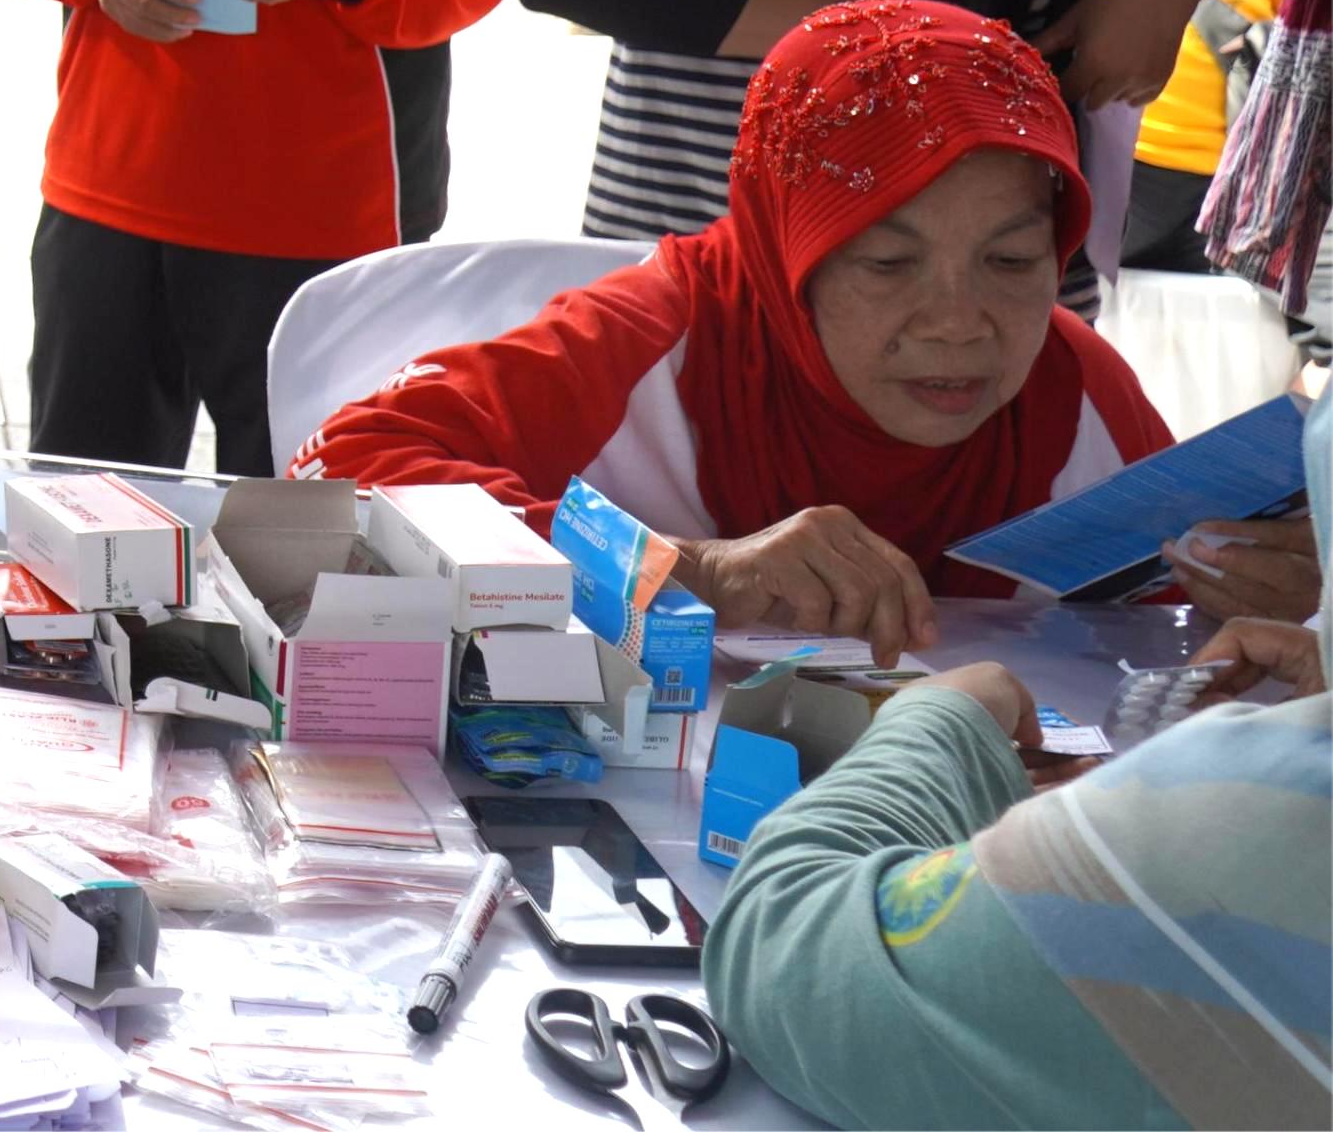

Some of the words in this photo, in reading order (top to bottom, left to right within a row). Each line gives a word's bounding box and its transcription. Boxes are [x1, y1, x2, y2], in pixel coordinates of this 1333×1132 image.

[104, 536, 112, 603] DEXAMETHASONE
[469, 592, 523, 602] Betahistine
[524, 592, 565, 602] Mesilate
